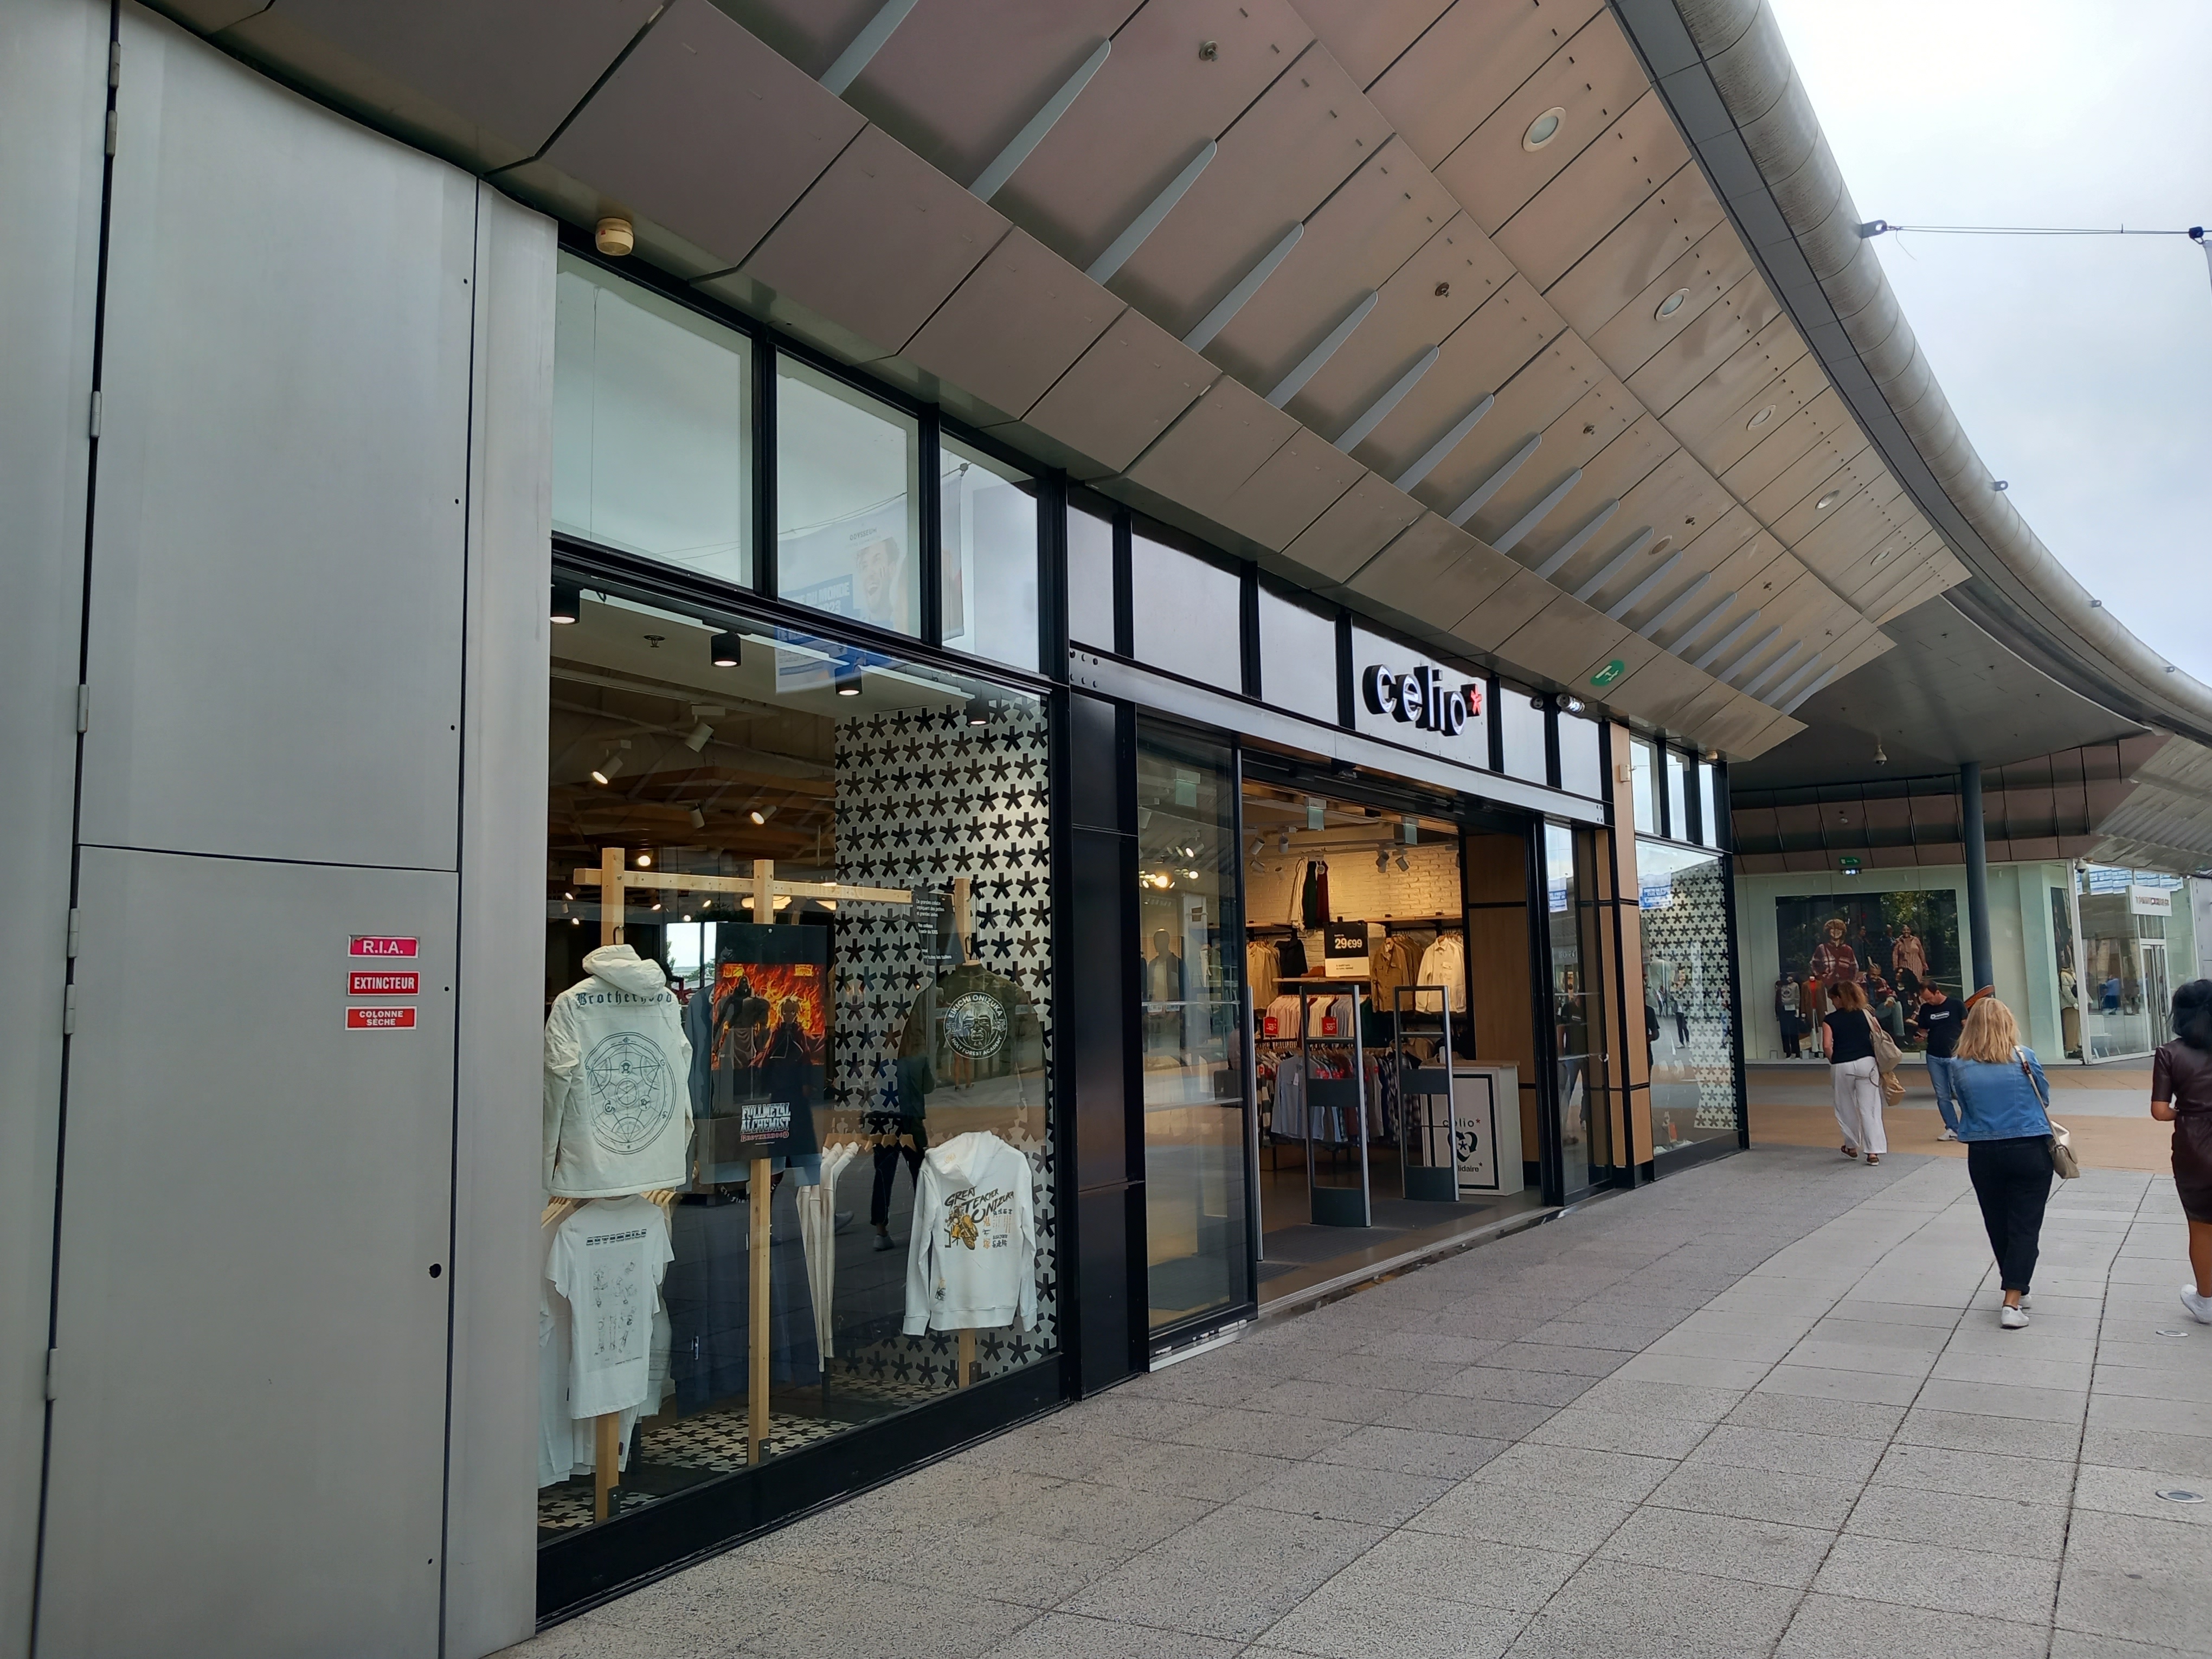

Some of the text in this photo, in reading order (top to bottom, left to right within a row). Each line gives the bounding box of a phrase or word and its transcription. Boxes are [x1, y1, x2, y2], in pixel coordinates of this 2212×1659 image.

[819, 582, 850, 602] MONDE
[1362, 664, 1467, 736] celio
[363, 940, 403, 954] R.I.A.
[1335, 938, 1362, 949] 29€99
[354, 977, 415, 989] EXTINCTEUR
[948, 994, 1003, 1018] EIKICHI ONIZUKA
[366, 1017, 396, 1026] SÈCHE
[951, 1038, 963, 1050] HOLY
[983, 1034, 1002, 1055] ACADEMY
[742, 1102, 791, 1120] FULLMETAL
[740, 1117, 790, 1134] ALCHEMIST
[944, 1186, 977, 1207] GREAT
[961, 1188, 999, 1213] TEACHER
[972, 1191, 1014, 1223] ONIZUKA
